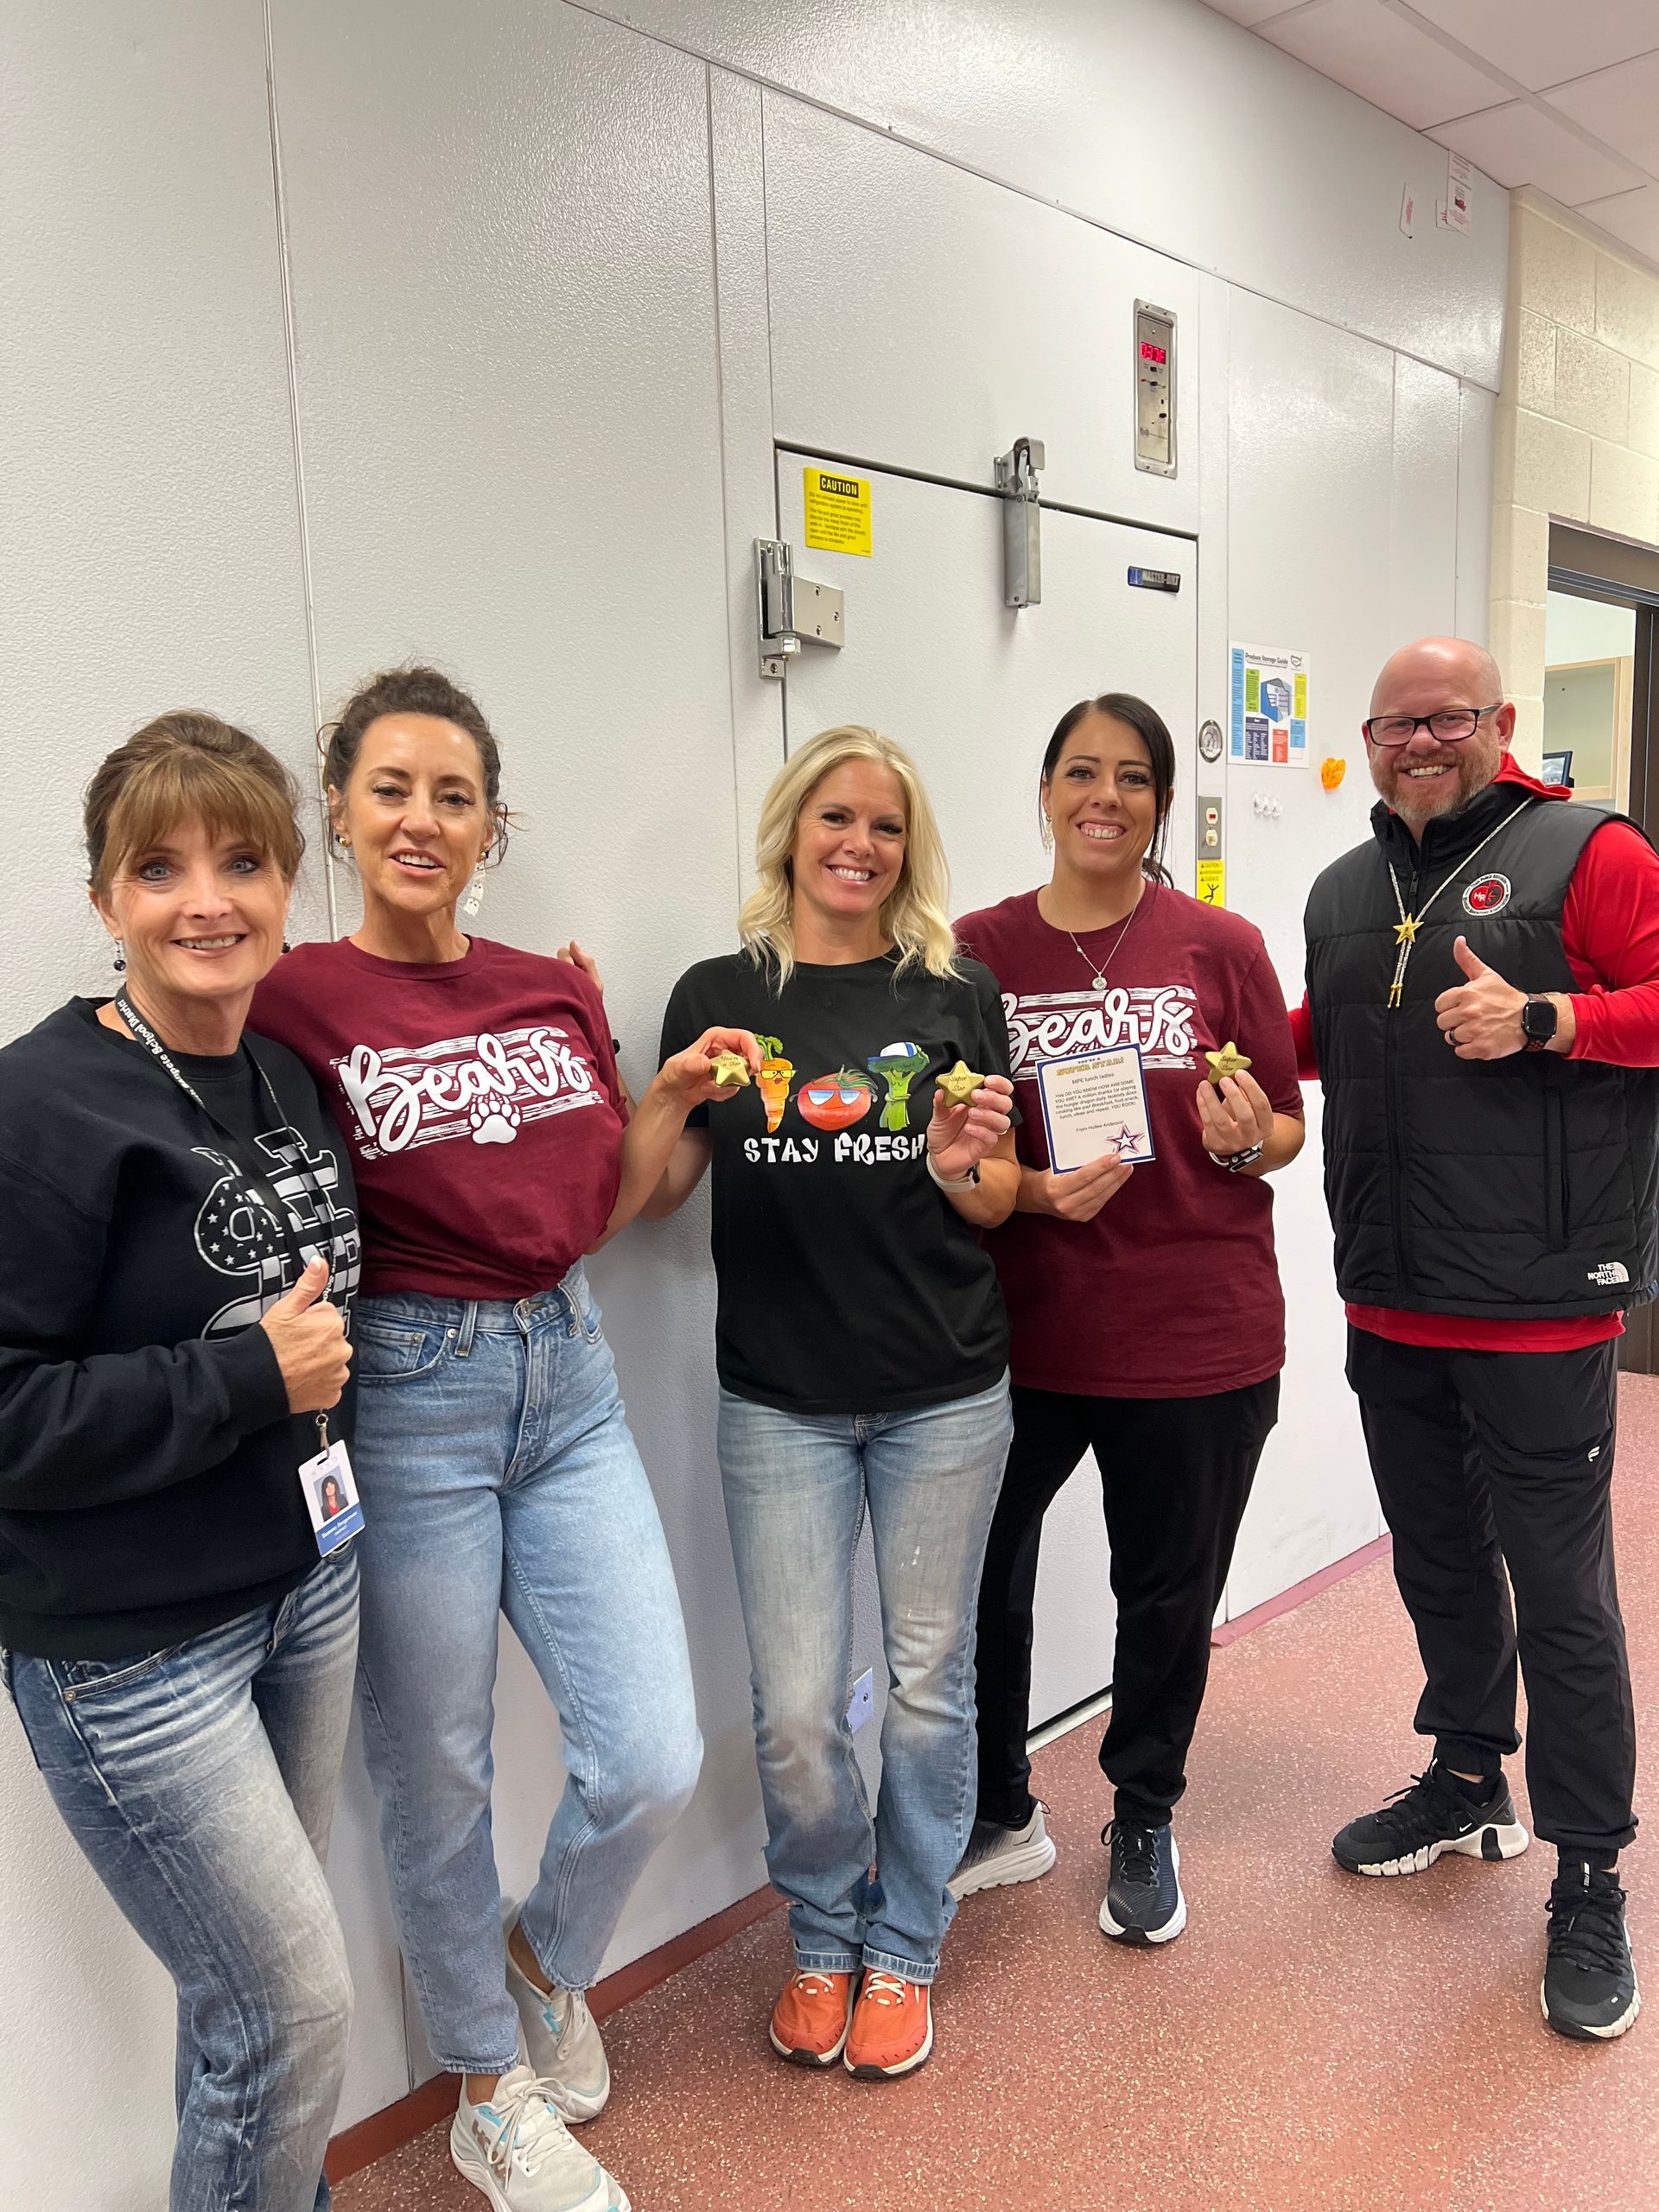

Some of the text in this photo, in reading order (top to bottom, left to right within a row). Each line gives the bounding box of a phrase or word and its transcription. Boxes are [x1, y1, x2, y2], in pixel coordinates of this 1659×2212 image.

[821, 478, 857, 495] CAUTION
[1474, 892, 1486, 901] HR
[118, 999, 140, 1028] District
[134, 1024, 163, 1055] School
[1056, 1064, 1090, 1076] SUPER
[950, 1076, 967, 1084] Super
[338, 1029, 591, 1153] Bears
[744, 1132, 925, 1166] STAY FRESH
[1587, 1270, 1615, 1280] NORTH
[1597, 1277, 1618, 1286] FACE
